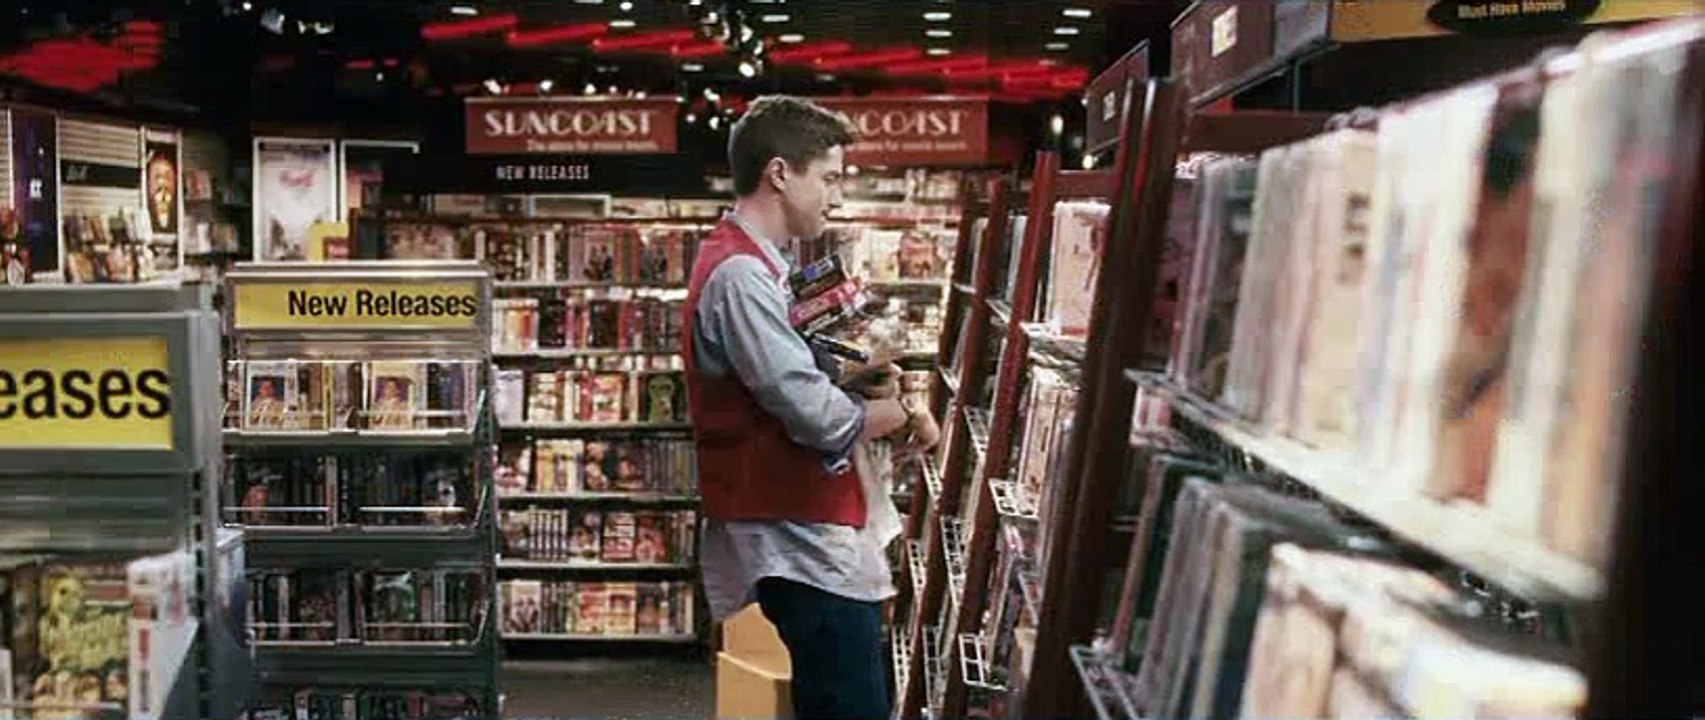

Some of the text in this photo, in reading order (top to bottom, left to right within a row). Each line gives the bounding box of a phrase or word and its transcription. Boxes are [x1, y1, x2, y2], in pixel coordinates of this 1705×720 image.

[485, 109, 653, 137] SUNCOAST
[497, 165, 590, 179] NEW RELEASES
[288, 290, 477, 316] New Releases
